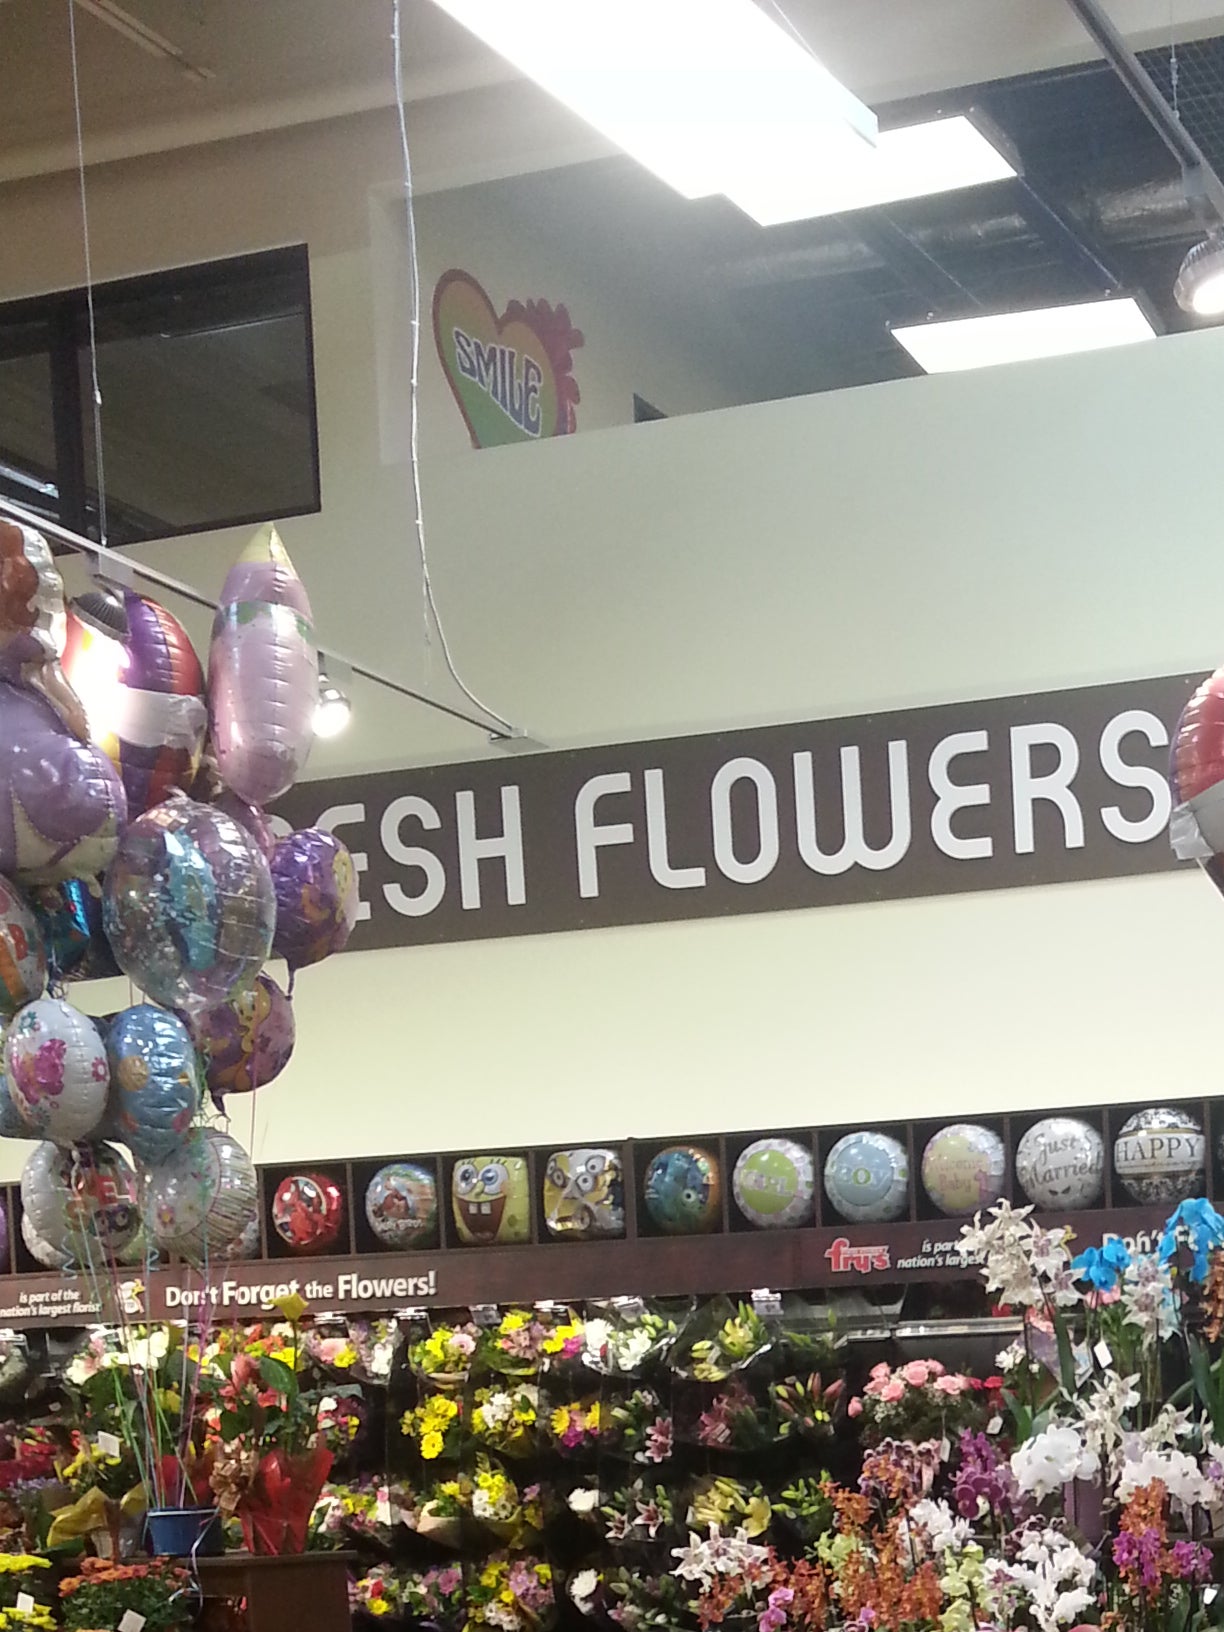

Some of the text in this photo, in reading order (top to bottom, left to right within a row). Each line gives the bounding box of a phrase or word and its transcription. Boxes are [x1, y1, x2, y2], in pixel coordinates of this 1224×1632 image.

[453, 327, 543, 438] SMILE
[268, 709, 1172, 920] ESH FLOWERS
[1116, 1136, 1201, 1163] HAPPY
[921, 1238, 932, 1253] is
[222, 1279, 300, 1311] Forget
[304, 1280, 334, 1300] the
[337, 1270, 437, 1301] Flowers!
